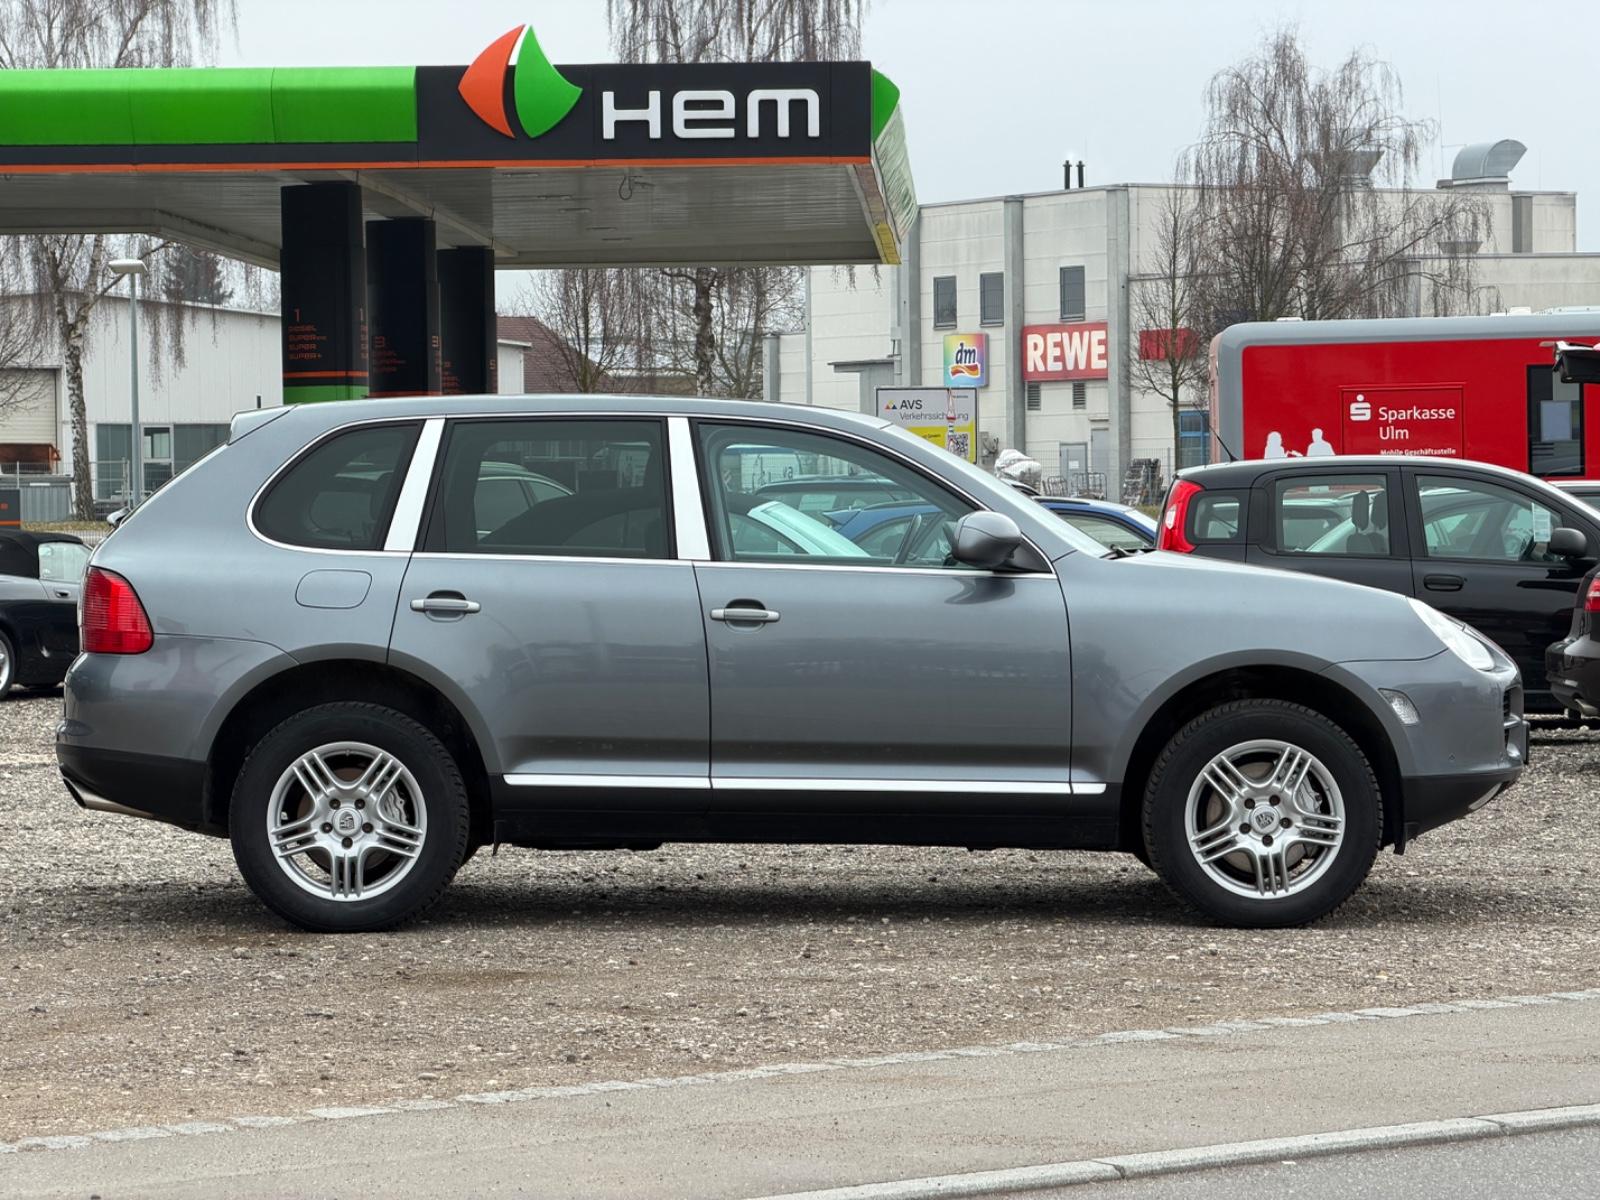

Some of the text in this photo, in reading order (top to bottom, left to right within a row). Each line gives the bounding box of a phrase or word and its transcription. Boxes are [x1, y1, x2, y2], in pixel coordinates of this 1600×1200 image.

[294, 308, 300, 322] 1
[956, 342, 977, 364] dm
[1027, 330, 1107, 372] REWE
[900, 400, 923, 410] AVS
[900, 411, 969, 421] Verkehrssichung
[1379, 405, 1456, 423] Sparkasse
[1379, 425, 1409, 440] Ulm
